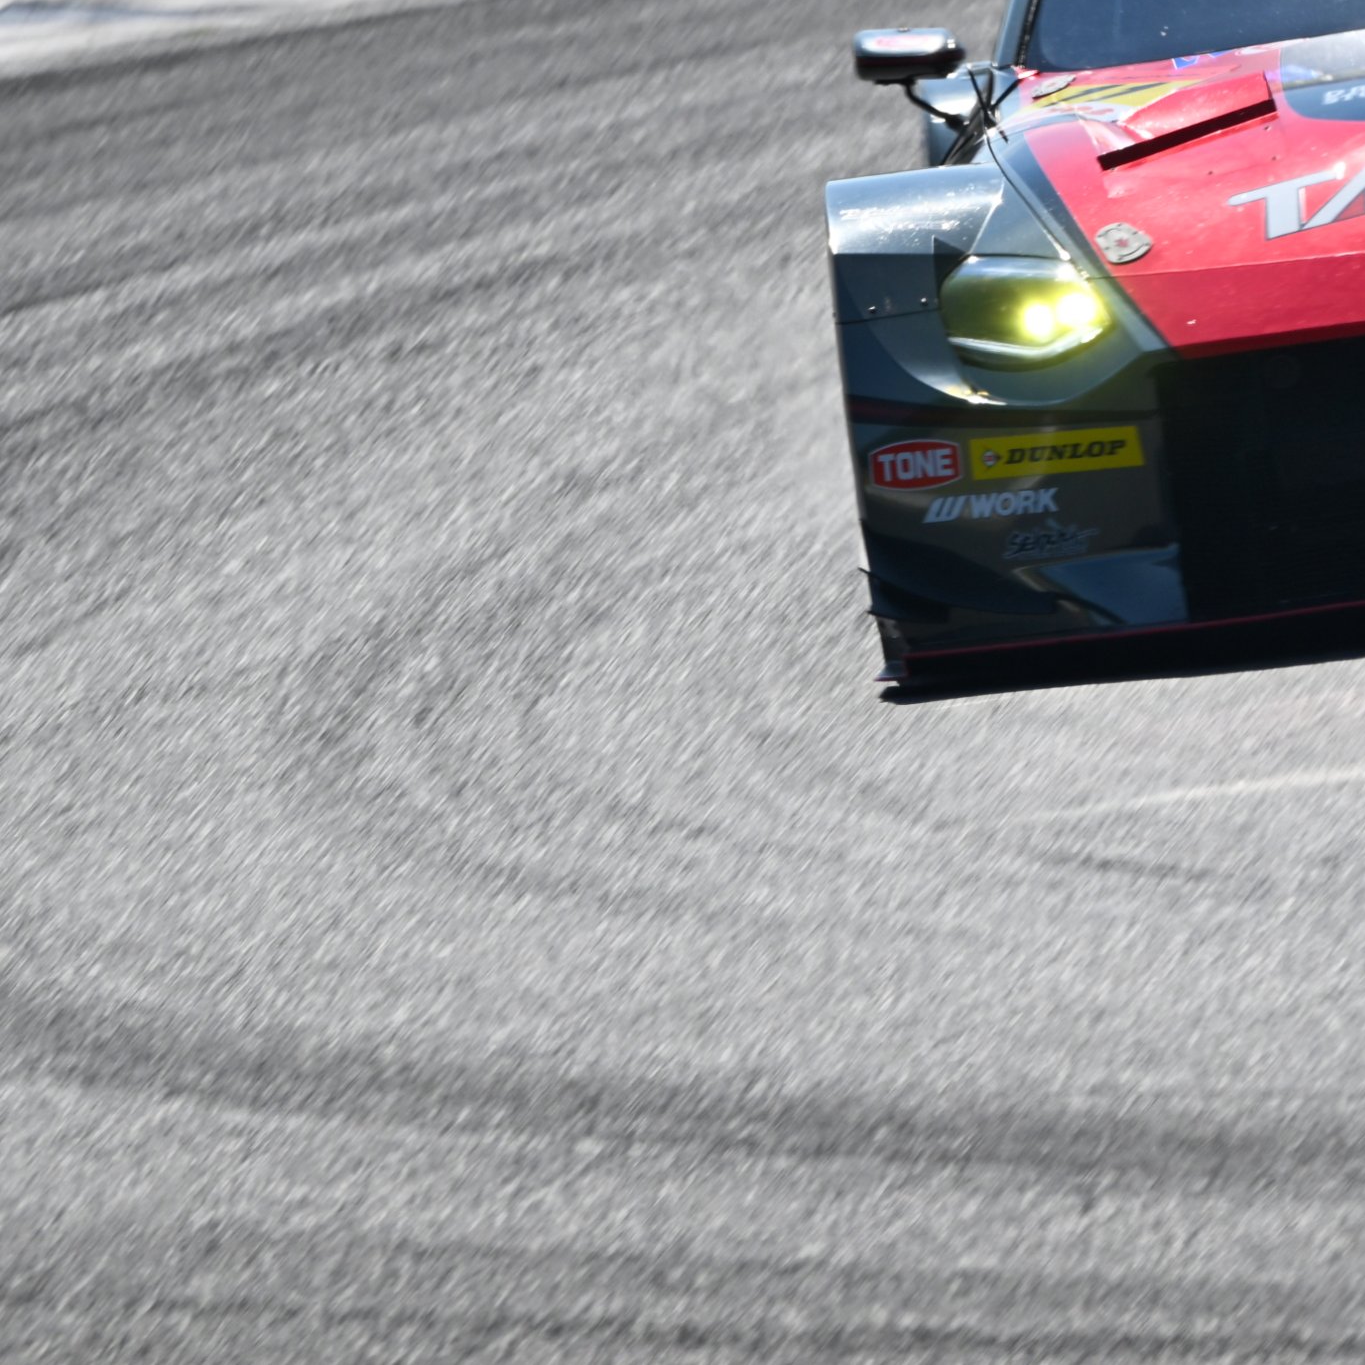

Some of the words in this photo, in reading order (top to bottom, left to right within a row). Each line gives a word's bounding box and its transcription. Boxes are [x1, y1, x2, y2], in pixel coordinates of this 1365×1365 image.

[876, 447, 955, 483] TONE
[1004, 438, 1128, 466] DUNLOP
[968, 486, 1059, 519] WORK
